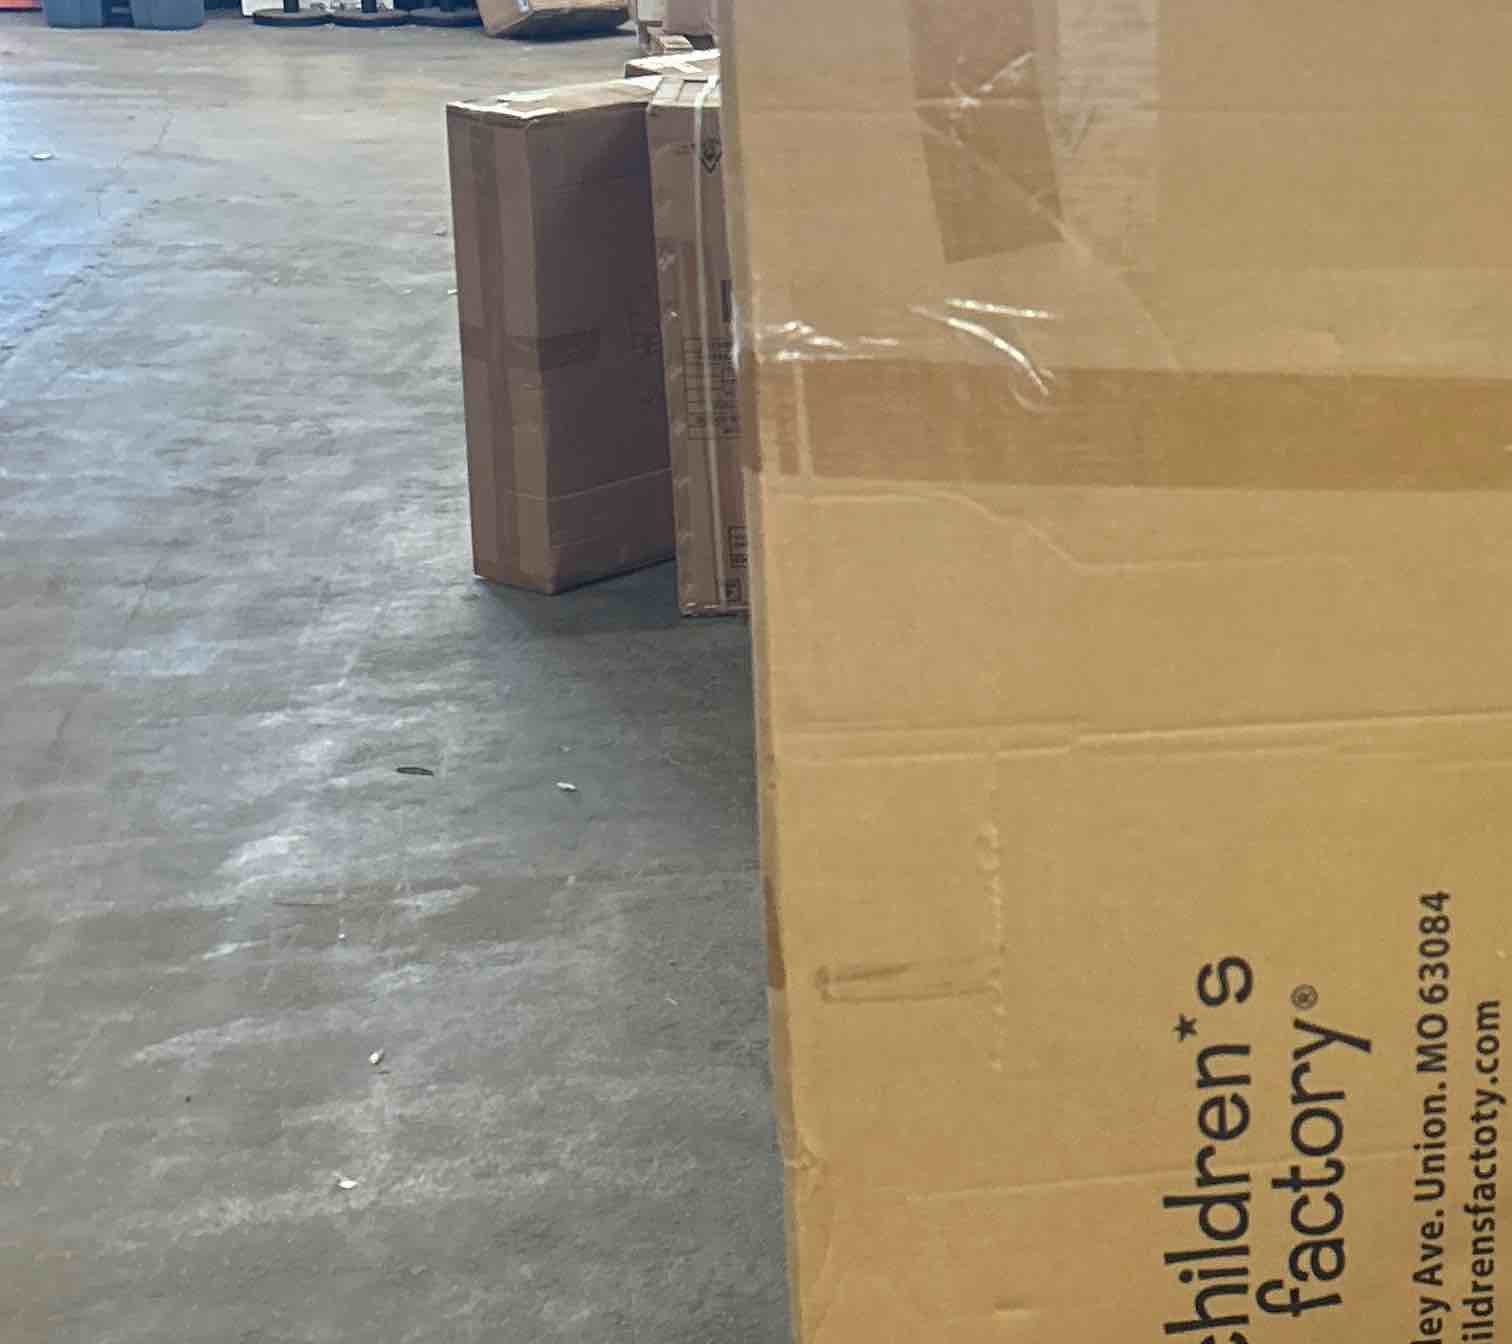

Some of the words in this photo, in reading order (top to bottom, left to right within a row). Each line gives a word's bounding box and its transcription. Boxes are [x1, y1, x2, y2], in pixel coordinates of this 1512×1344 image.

[1418, 891, 1451, 1005] 63084
[1415, 1013, 1449, 1073] MO
[1411, 1209, 1445, 1287] Ave.
